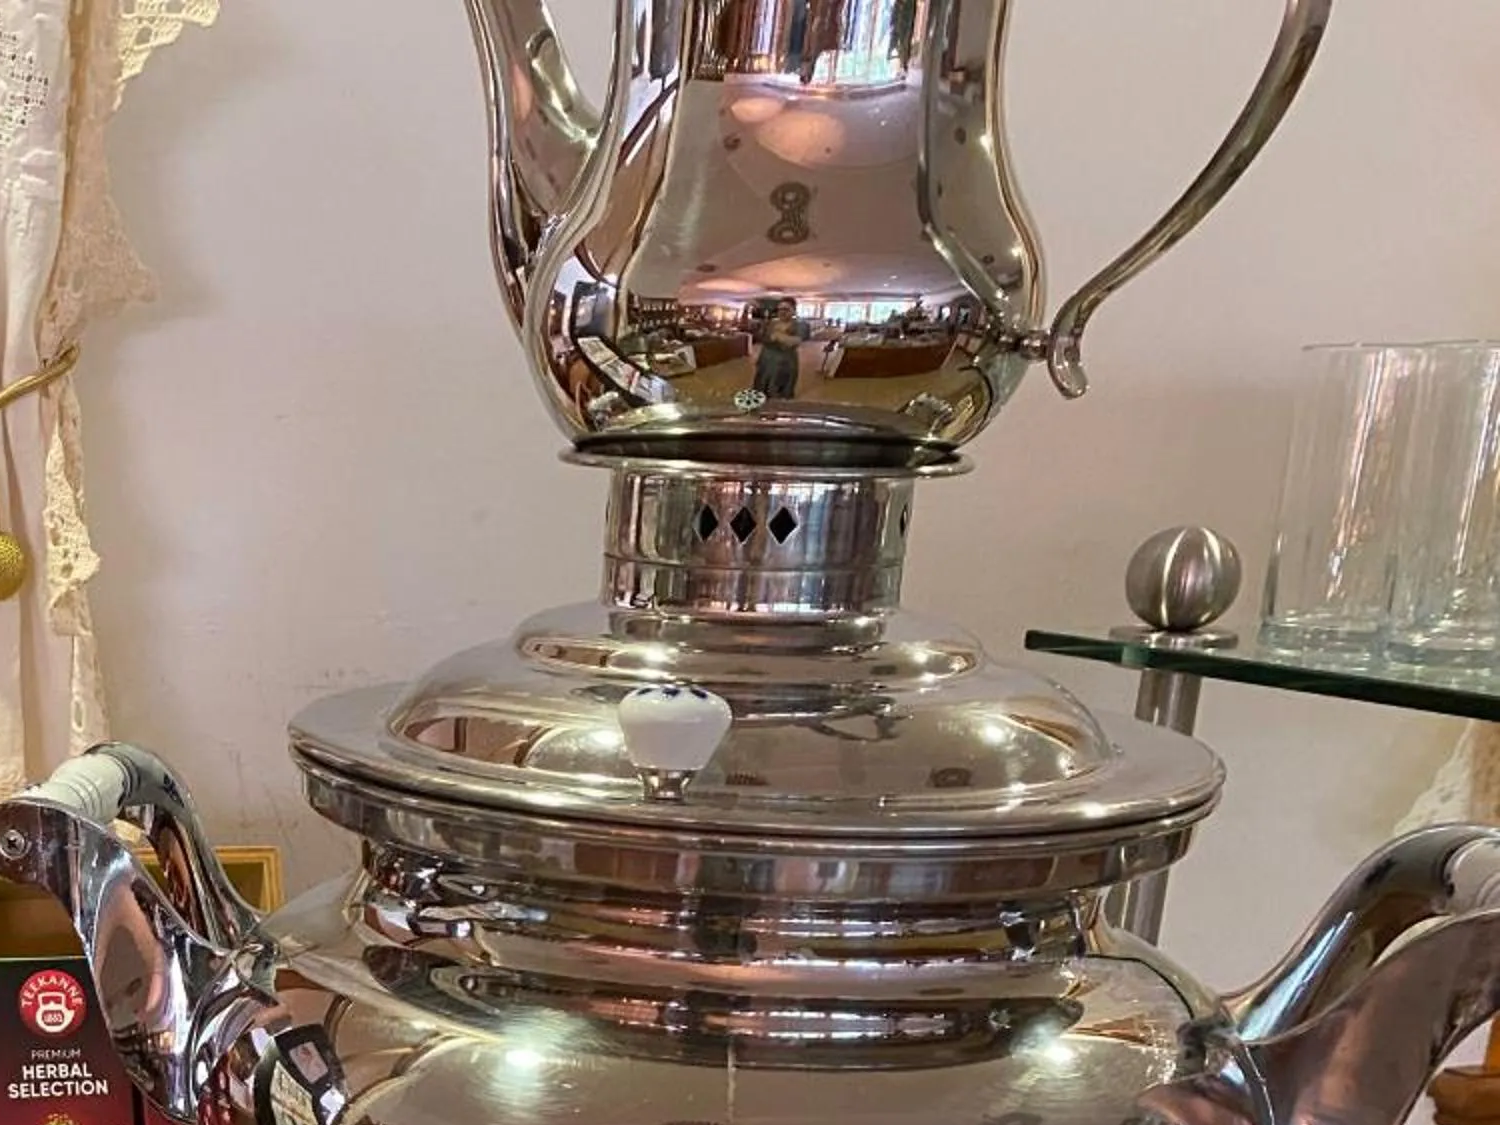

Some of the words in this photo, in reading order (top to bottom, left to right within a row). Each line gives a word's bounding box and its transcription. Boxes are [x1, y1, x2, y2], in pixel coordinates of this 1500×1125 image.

[21, 975, 84, 1008] TEEKANNE
[31, 1048, 81, 1060] PREMIUM
[23, 1062, 93, 1080] HERBAL
[8, 1080, 109, 1100] SELECTION
